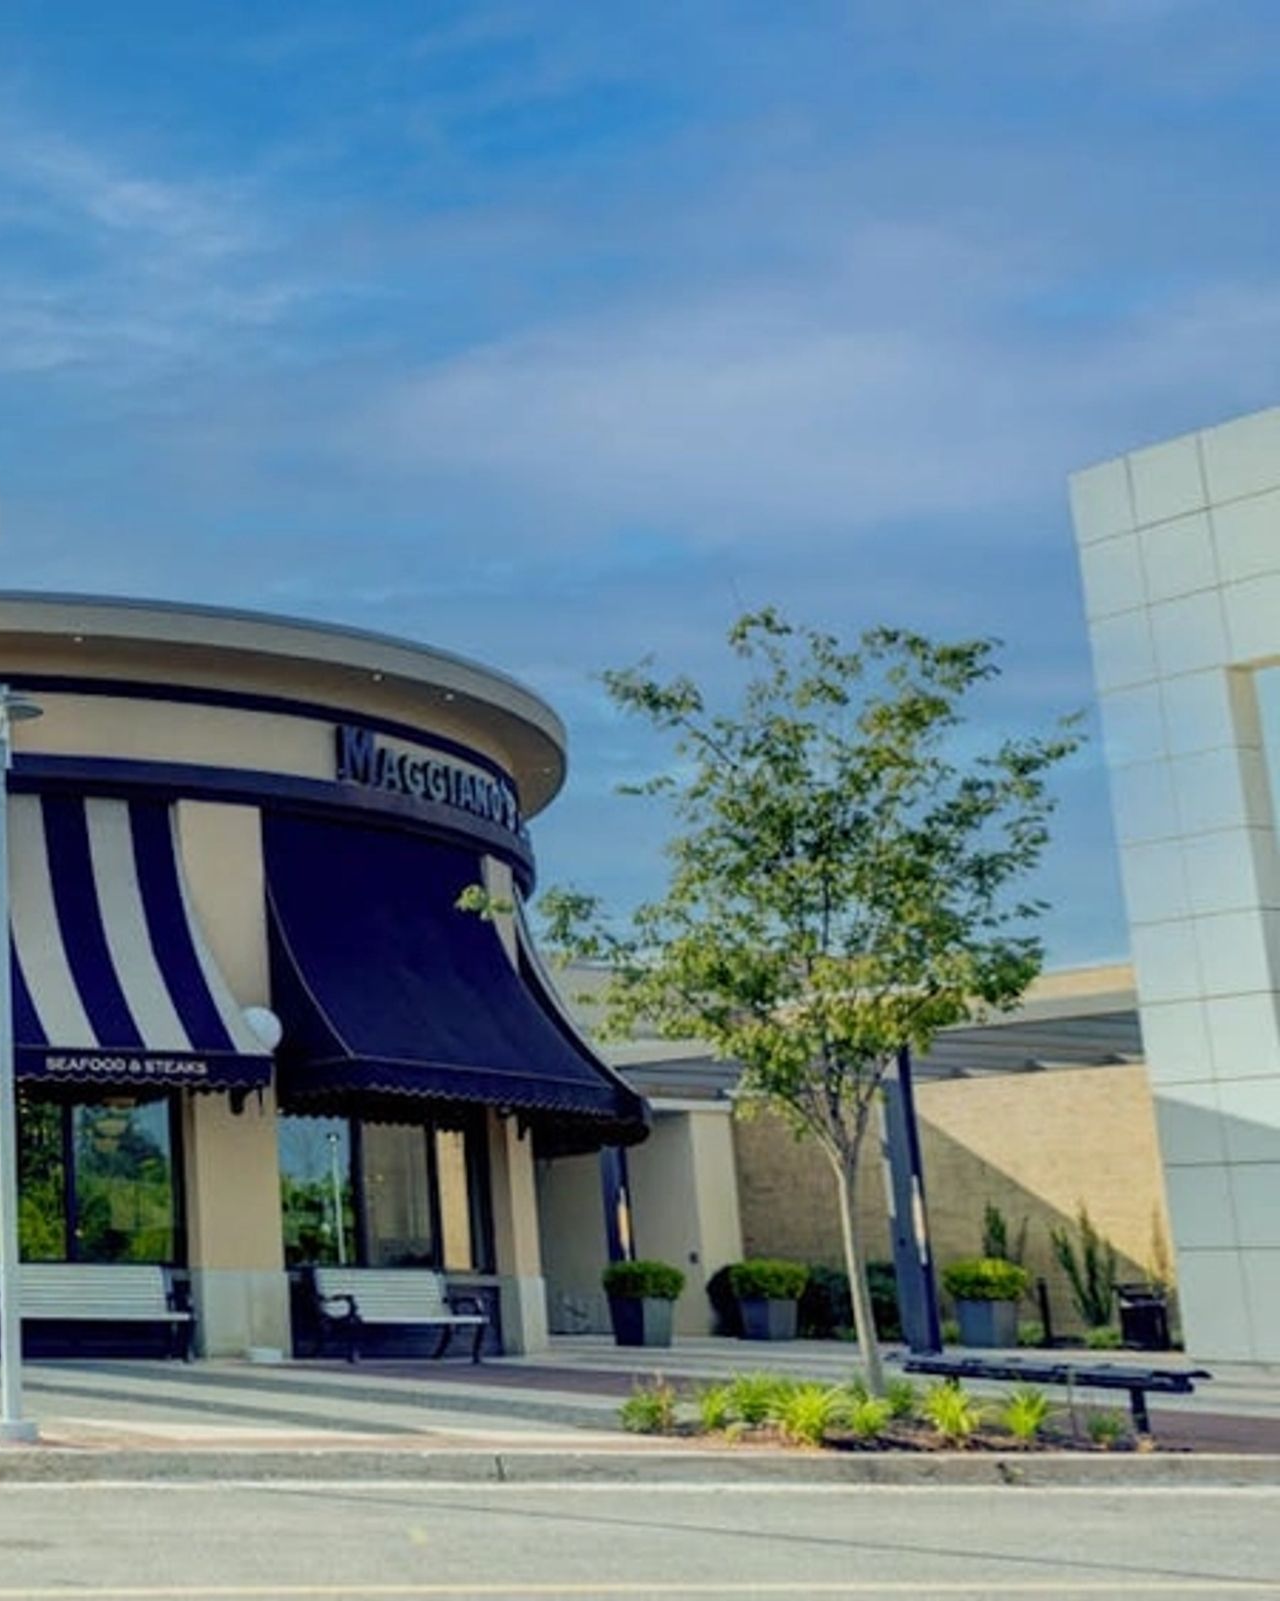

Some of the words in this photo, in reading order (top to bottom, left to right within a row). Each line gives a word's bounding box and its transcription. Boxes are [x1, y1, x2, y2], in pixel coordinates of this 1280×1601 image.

[45, 1057, 126, 1072] SEAFOOD
[128, 1058, 141, 1073] &
[144, 1059, 208, 1075] STEAKS
